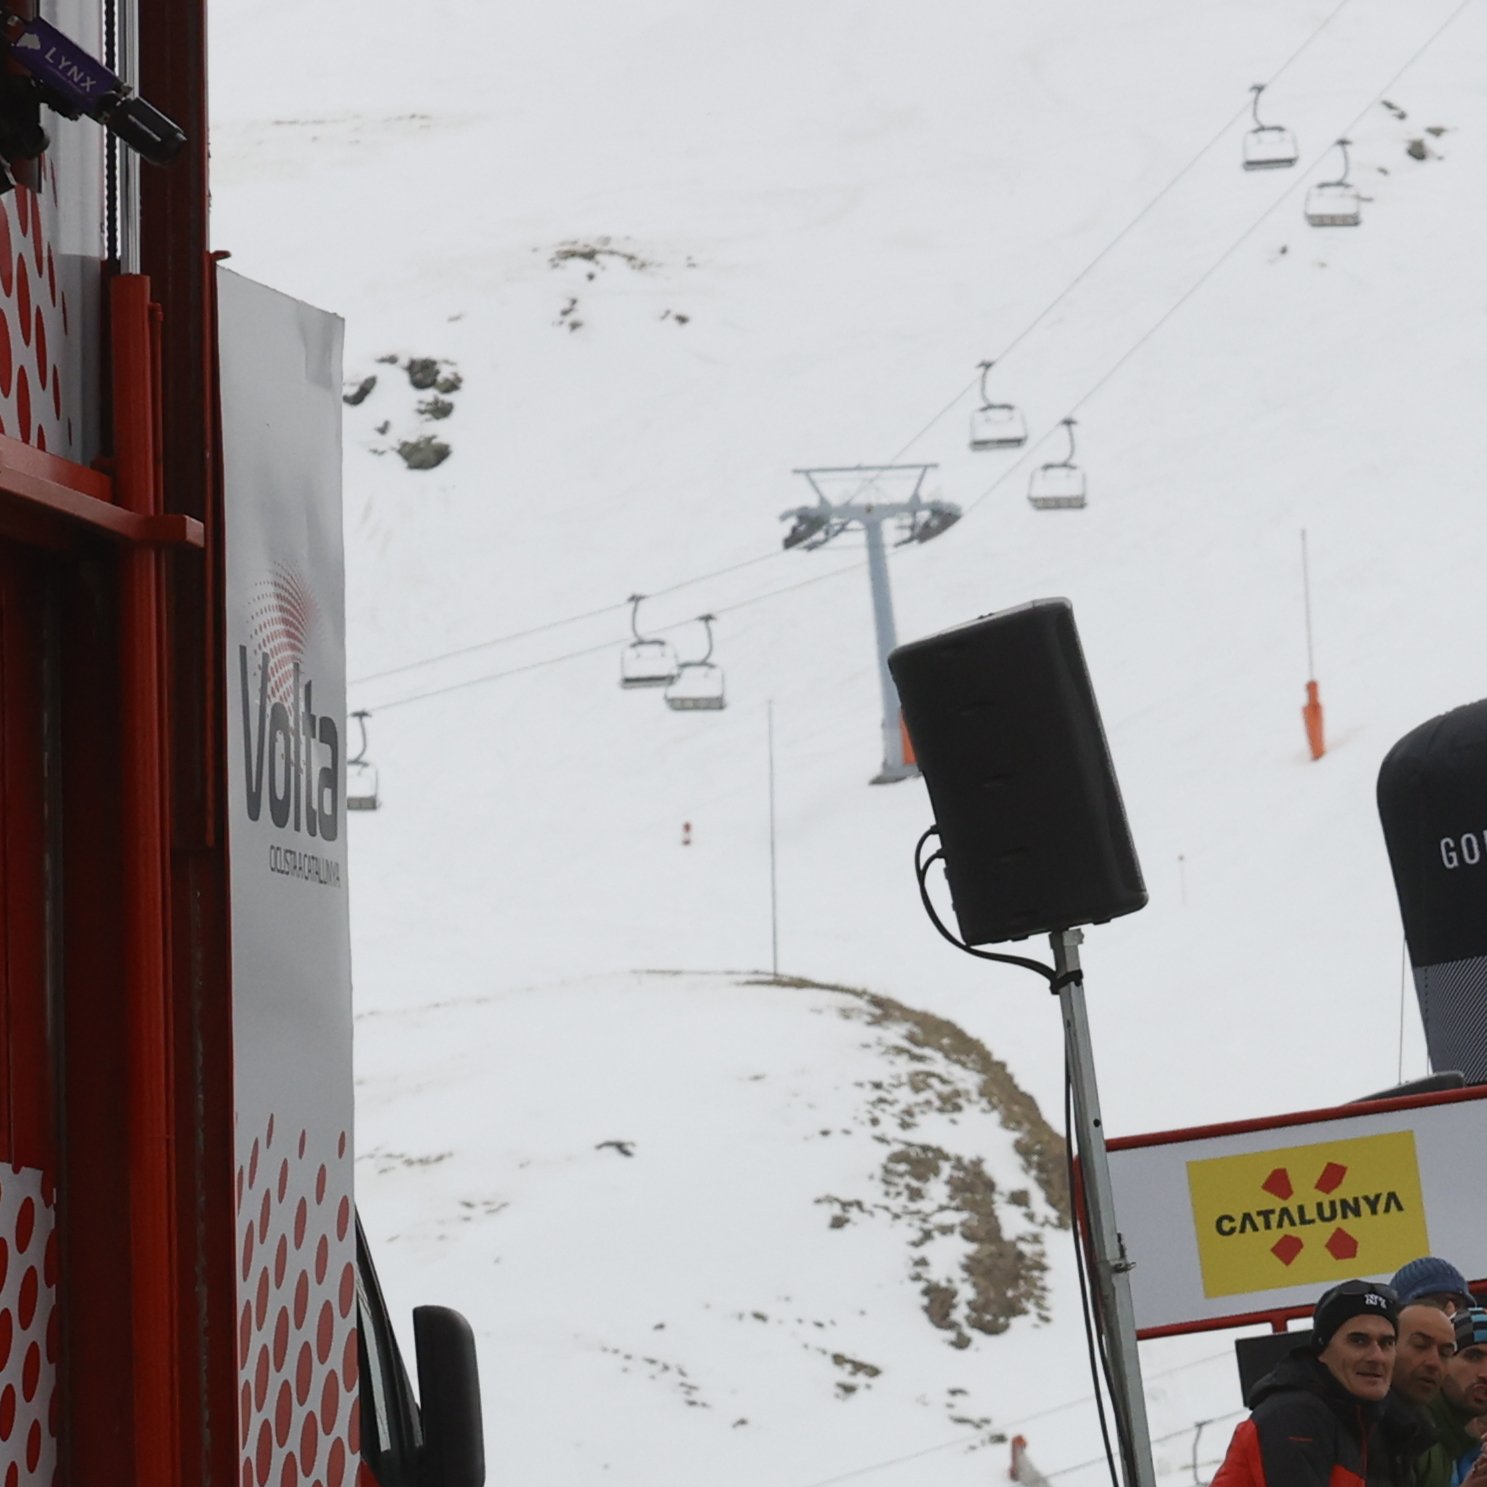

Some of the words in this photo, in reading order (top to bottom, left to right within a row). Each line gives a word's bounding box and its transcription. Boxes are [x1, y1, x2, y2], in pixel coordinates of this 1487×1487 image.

[45, 47, 97, 92] LYNX
[239, 644, 338, 842] Volta
[1214, 1191, 1405, 1237] CATALUNYA
